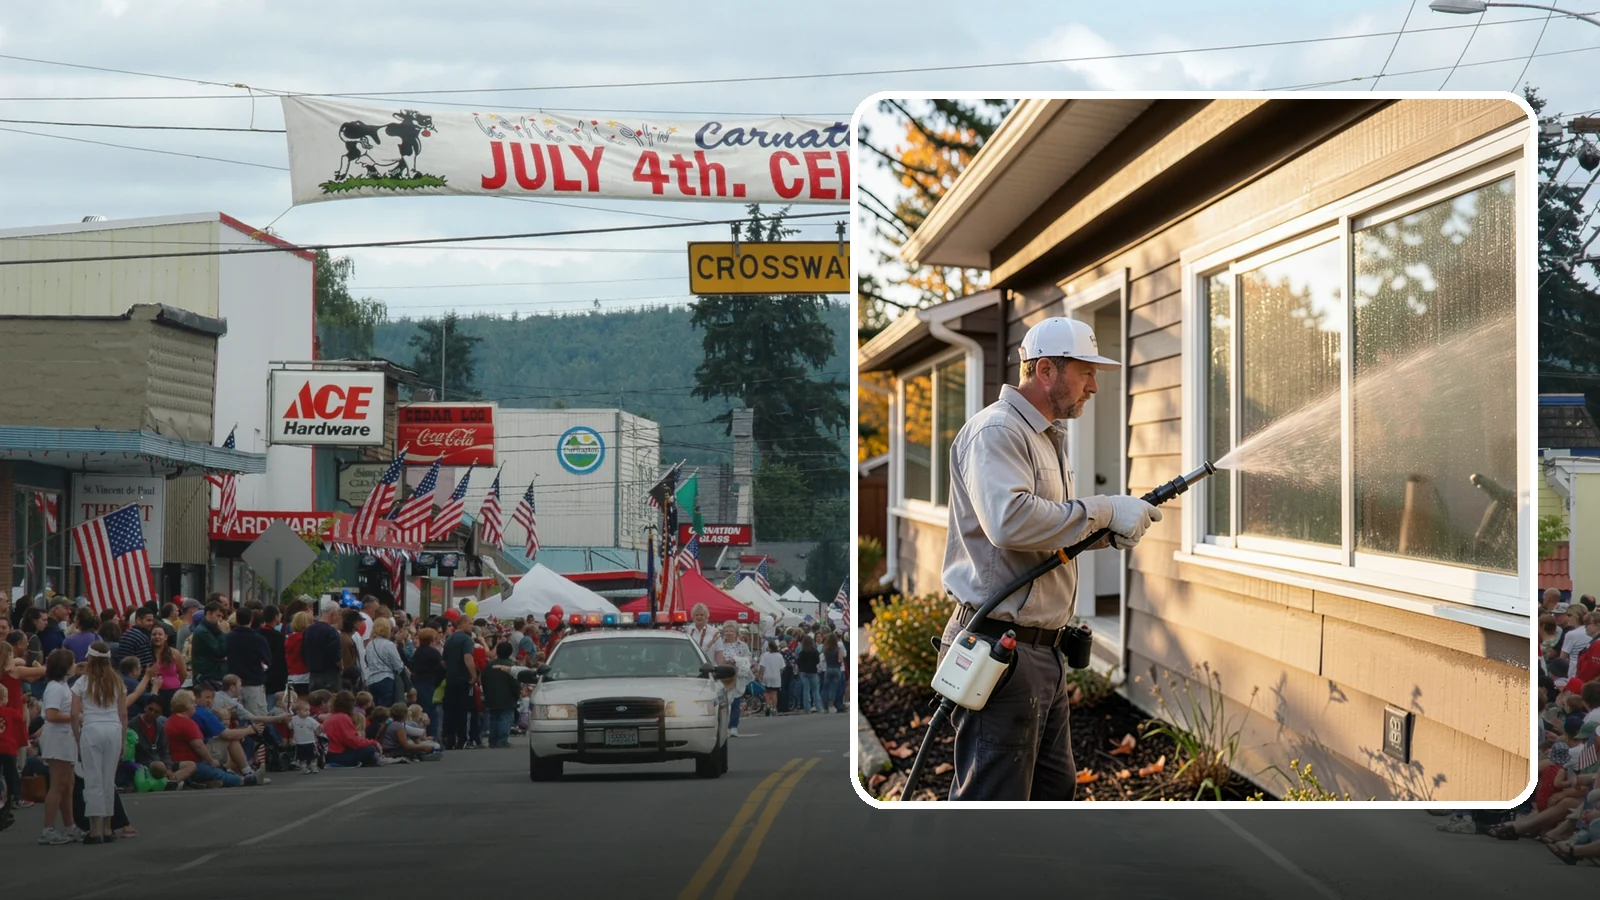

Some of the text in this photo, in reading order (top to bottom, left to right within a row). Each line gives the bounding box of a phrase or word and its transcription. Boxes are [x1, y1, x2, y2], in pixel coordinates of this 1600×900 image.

[481, 141, 605, 192] JULY
[632, 150, 746, 198] 4th.
[697, 254, 850, 280] CROSSWA
[282, 380, 373, 420] ACE
[405, 409, 453, 422] CEDAR
[283, 421, 371, 436] Hardware
[95, 485, 124, 495] Vincent
[126, 486, 135, 495] de
[137, 486, 155, 495] Paul
[81, 503, 153, 521] THT
[688, 526, 741, 535] CRNATION
[699, 535, 730, 543] GLASS
